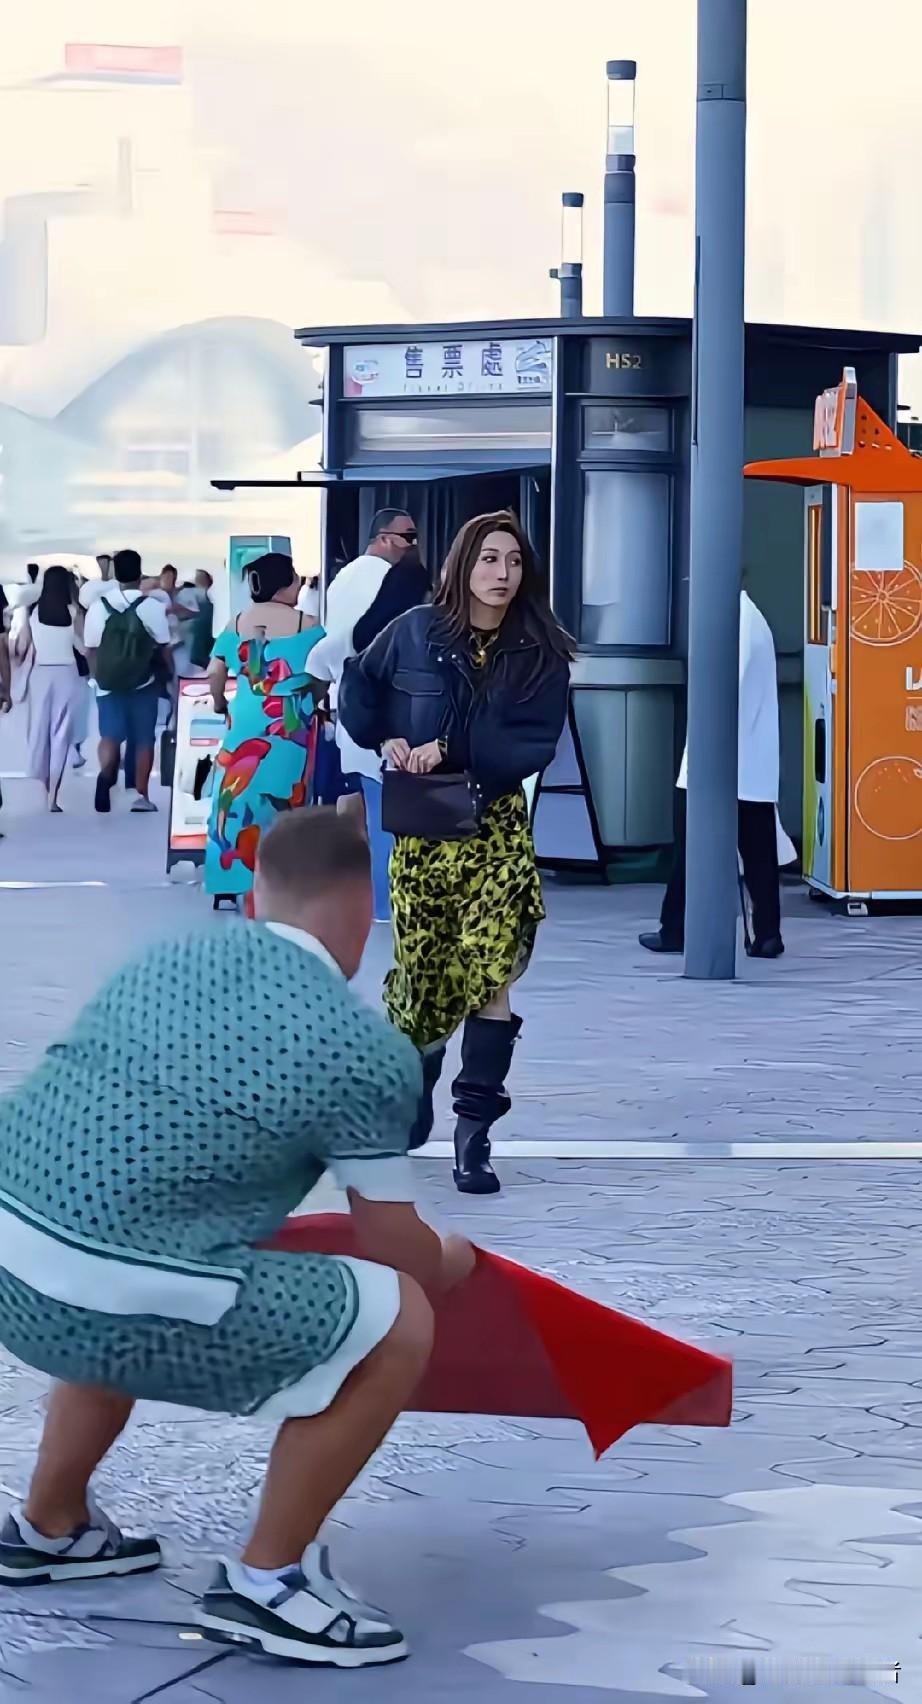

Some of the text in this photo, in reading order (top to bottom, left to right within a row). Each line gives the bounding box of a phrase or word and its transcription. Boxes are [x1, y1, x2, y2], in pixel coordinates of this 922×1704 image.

[404, 342, 503, 378] 售票處
[605, 352, 641, 369] HS2
